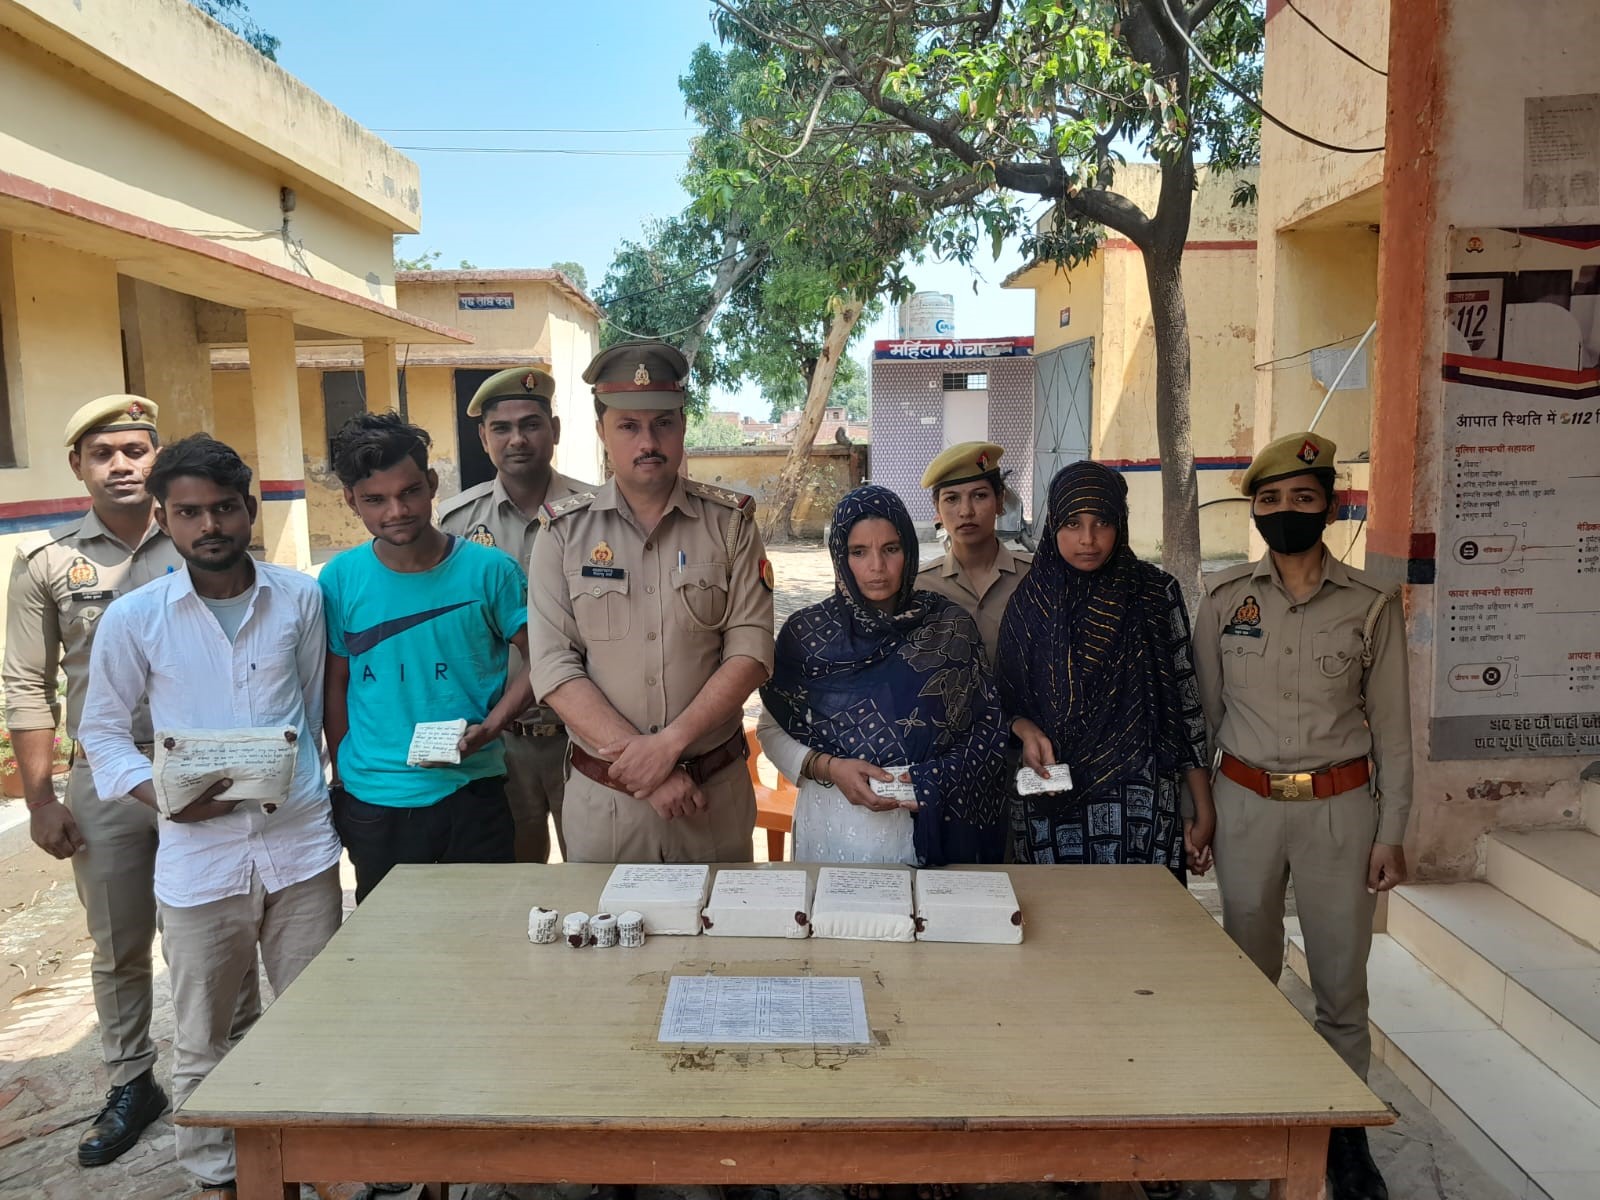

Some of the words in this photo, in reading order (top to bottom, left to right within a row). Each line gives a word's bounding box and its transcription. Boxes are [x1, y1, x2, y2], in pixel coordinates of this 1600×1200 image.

[1457, 304, 1488, 338] 112
[889, 340, 942, 359] महिला
[1456, 413, 1498, 427] आपात
[1502, 411, 1543, 426] स्थिति
[1547, 409, 1557, 425] में
[1571, 411, 1593, 425] 112
[1455, 444, 1476, 457] पुलिस
[1478, 443, 1506, 454] सम्बन्धी
[1507, 444, 1535, 454] सहायता
[1448, 588, 1469, 598] फायर
[1472, 586, 1501, 597] सम्बन्धी
[1503, 587, 1534, 597] सहायता
[1527, 733, 1566, 751] पुलिस
